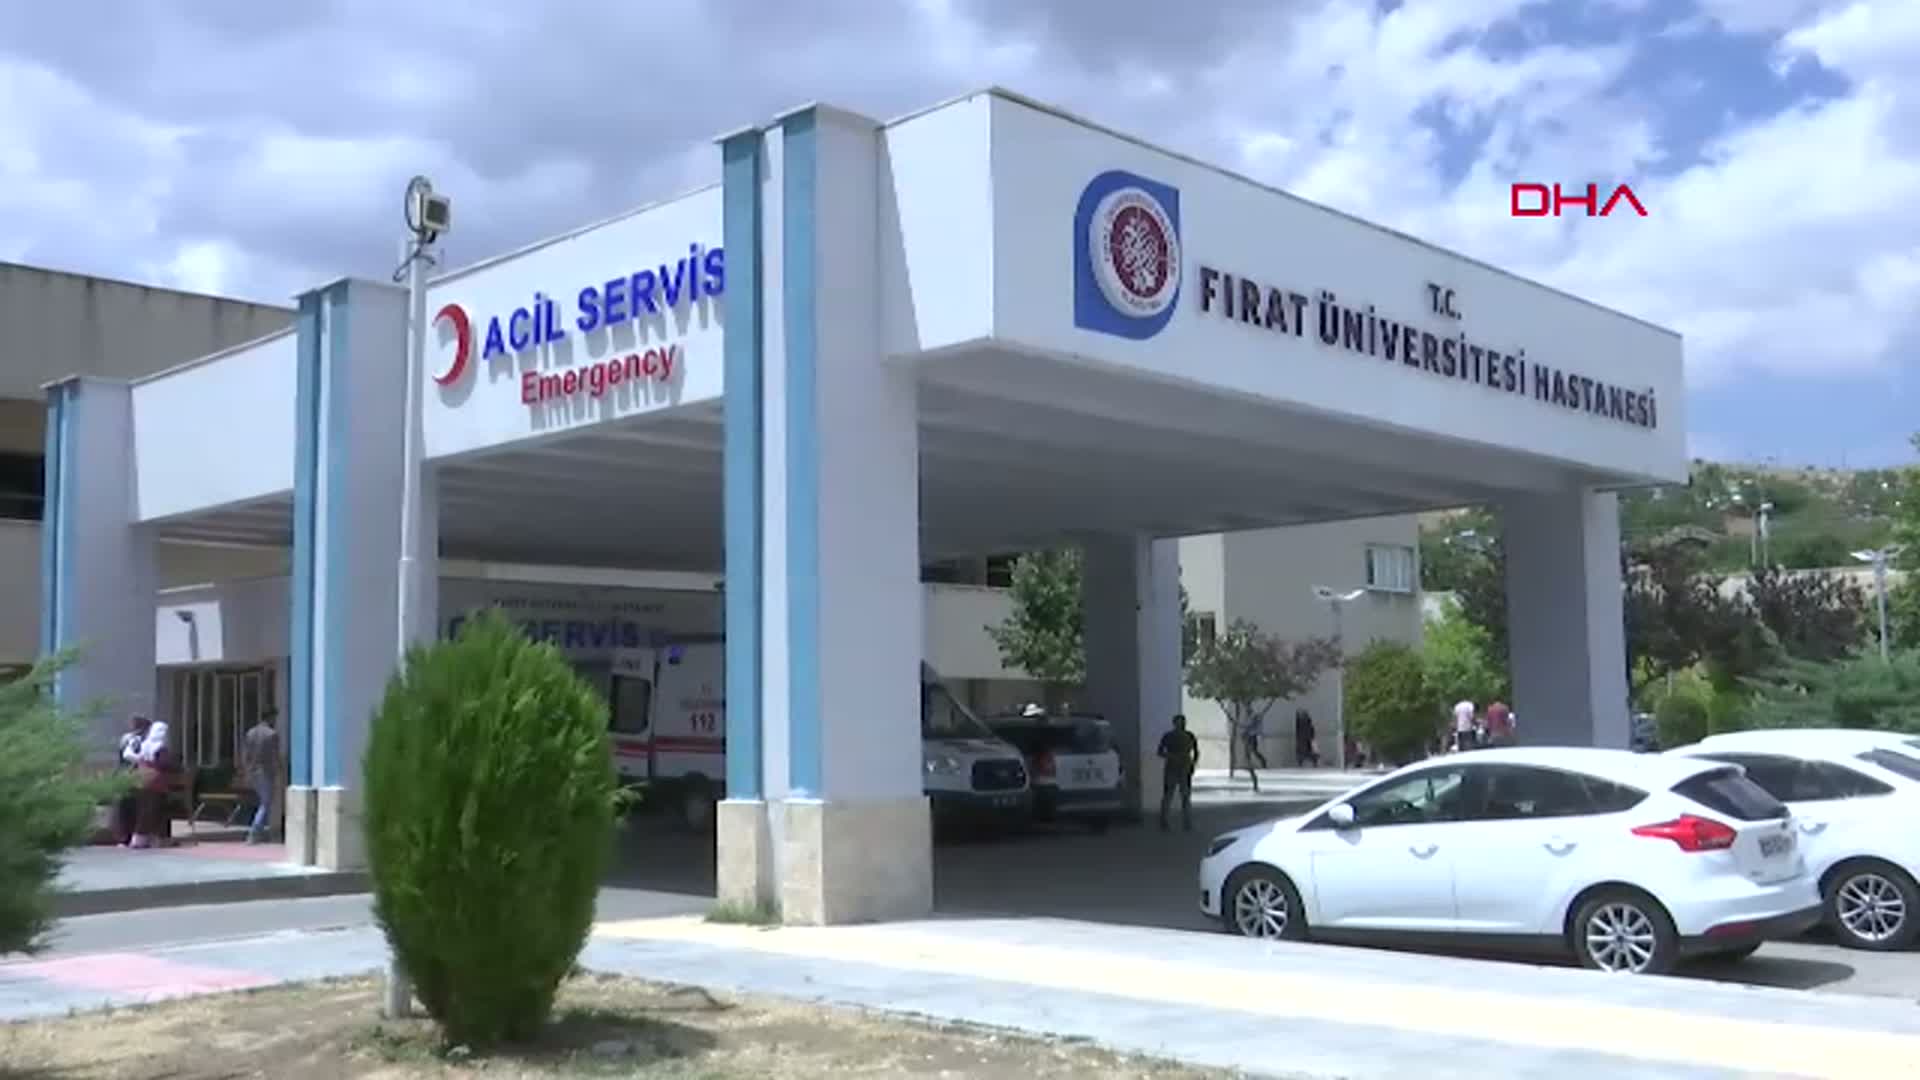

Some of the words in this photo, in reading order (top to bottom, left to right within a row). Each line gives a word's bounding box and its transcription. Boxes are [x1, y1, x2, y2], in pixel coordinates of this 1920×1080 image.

[482, 292, 565, 360] ACİL
[576, 243, 726, 332] SERVİS
[1428, 282, 1462, 320] T.C.
[520, 345, 677, 405] Emergency
[1200, 265, 1309, 338] FIRAT
[1318, 290, 1526, 396] ÜNİVERSİTESİ
[1533, 363, 1658, 429] HASTANESİ
[690, 711, 716, 732] 112
